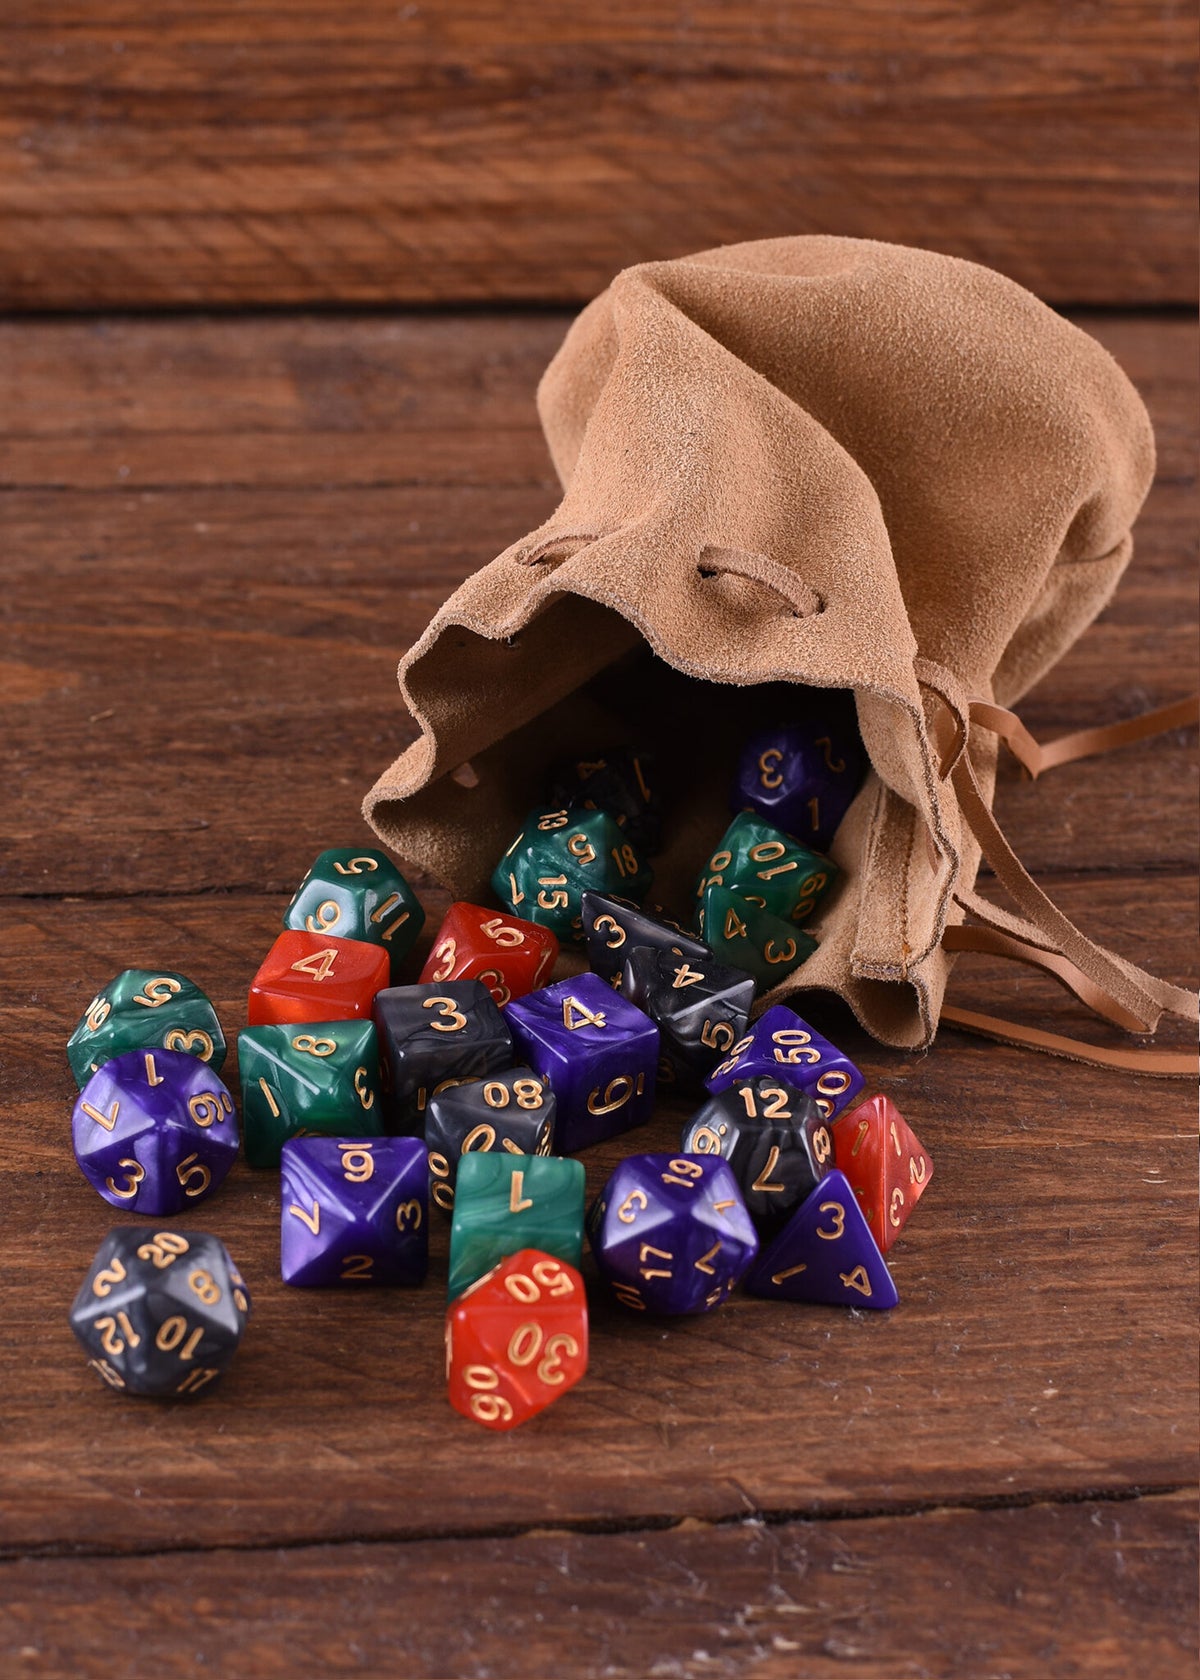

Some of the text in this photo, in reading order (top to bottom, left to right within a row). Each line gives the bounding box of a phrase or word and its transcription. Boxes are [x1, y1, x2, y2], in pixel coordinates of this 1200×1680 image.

[759, 748, 783, 789] 3
[808, 797, 819, 831] 1
[333, 857, 379, 875] 5
[567, 833, 596, 865] 5
[611, 844, 639, 878] 18
[750, 841, 798, 880] 10
[537, 873, 569, 909] 15
[371, 894, 410, 941] 11
[480, 918, 525, 947] 5
[593, 914, 627, 949] 3
[723, 907, 747, 940] 4
[291, 949, 339, 982] 4
[433, 938, 457, 982] 3
[764, 938, 797, 964] 3
[133, 977, 182, 1008] 5
[672, 964, 705, 988] 4
[422, 996, 468, 1032] 3
[563, 996, 607, 1031] 4
[165, 1028, 214, 1062] 3
[292, 1035, 337, 1057] 8
[701, 1019, 735, 1052] 5
[772, 1029, 821, 1064] 50
[145, 1053, 164, 1087] 1
[354, 1066, 374, 1110] 3
[738, 1087, 792, 1119] 12
[80, 1101, 119, 1132] 7
[812, 1126, 831, 1164] 8
[851, 1120, 870, 1157] 1
[890, 1121, 902, 1157] 1
[105, 1158, 145, 1199] 3
[176, 1152, 212, 1197] 5
[661, 1159, 704, 1188] 19
[751, 1145, 785, 1192] 7
[909, 1156, 926, 1185] 2
[509, 1170, 533, 1213] 1
[618, 1190, 648, 1224] 3
[889, 1187, 904, 1227] 3
[289, 1200, 320, 1236] 7
[396, 1199, 422, 1232] 3
[816, 1201, 846, 1240] 3
[137, 1232, 190, 1270] 20
[340, 1254, 374, 1279] 2
[639, 1242, 674, 1280] 17
[93, 1257, 126, 1298] 2
[188, 1269, 221, 1306] 8
[504, 1260, 575, 1304] 50
[771, 1263, 807, 1285] 1
[839, 1265, 873, 1297] 4
[94, 1311, 141, 1356] 12
[155, 1315, 205, 1361] 10
[507, 1322, 579, 1386] 30
